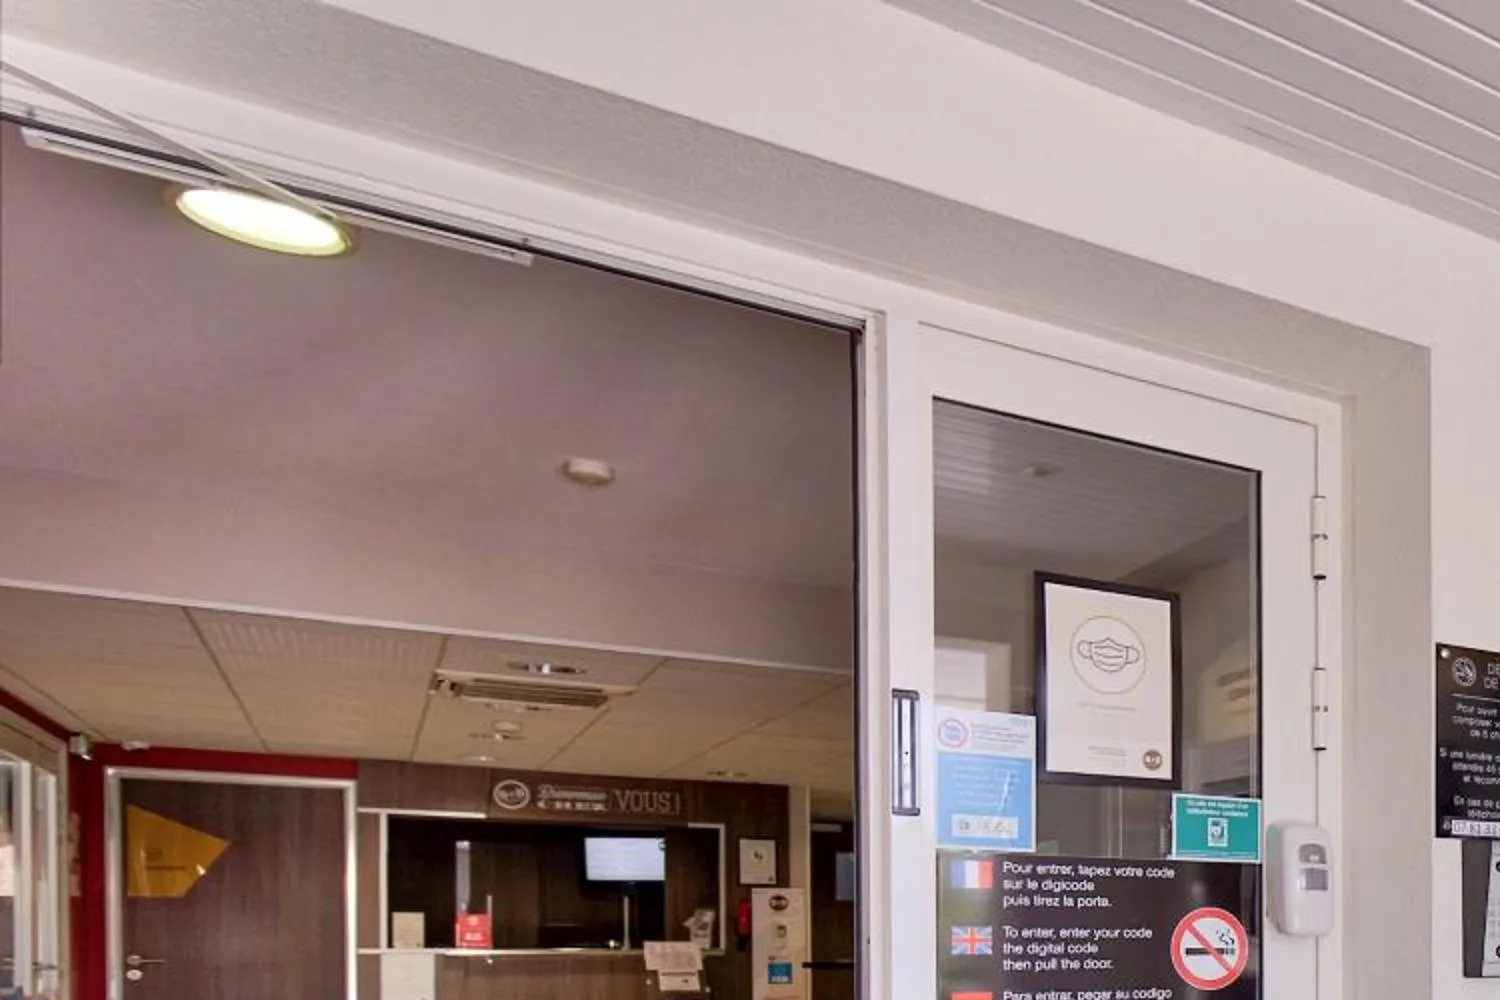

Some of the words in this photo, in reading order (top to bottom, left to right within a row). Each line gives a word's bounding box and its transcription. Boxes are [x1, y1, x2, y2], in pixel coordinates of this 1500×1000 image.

[1484, 677, 1498, 689] DE
[1003, 861, 1033, 873] Pour
[1078, 865, 1111, 878] tapez
[1113, 865, 1143, 877] votre
[1146, 866, 1175, 878] code
[1003, 879, 1024, 889] sur
[1027, 878, 1038, 890] le
[1042, 879, 1094, 893] digicode
[1003, 895, 1031, 908] puis
[1033, 895, 1060, 907] tirez
[1063, 895, 1074, 907] la
[1002, 925, 1018, 938] To
[1060, 927, 1090, 938] enter
[1094, 928, 1120, 941] your
[1124, 927, 1152, 938] code
[1003, 943, 1024, 954] the
[1027, 942, 1064, 956] digital
[1068, 942, 1099, 954] code
[1003, 958, 1031, 971] then
[1035, 958, 1057, 972] pull
[1061, 958, 1081, 969] the
[1115, 990, 1129, 999] su
